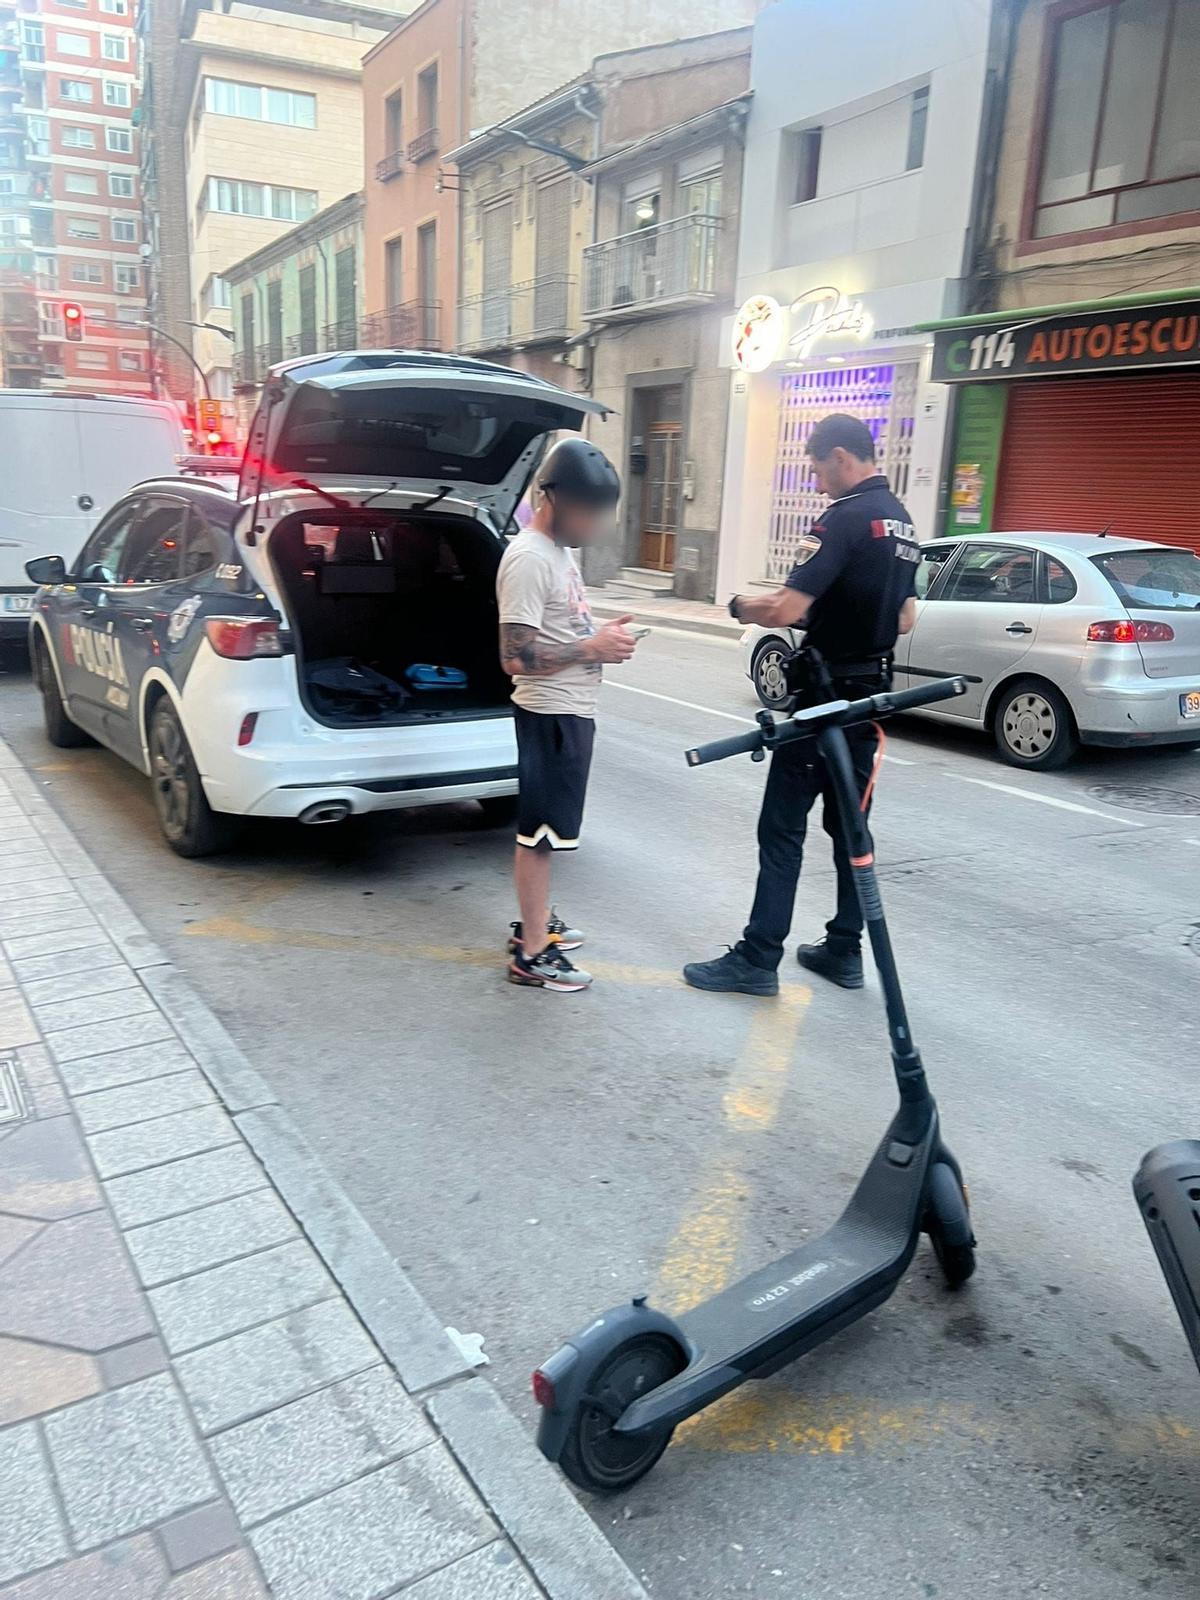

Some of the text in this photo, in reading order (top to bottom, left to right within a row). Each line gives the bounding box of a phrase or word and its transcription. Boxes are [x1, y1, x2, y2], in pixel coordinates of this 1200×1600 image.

[945, 315, 1200, 373] C114 AUTOESCU
[70, 621, 130, 689] POLICÍA
[752, 1292, 776, 1307] Pro
